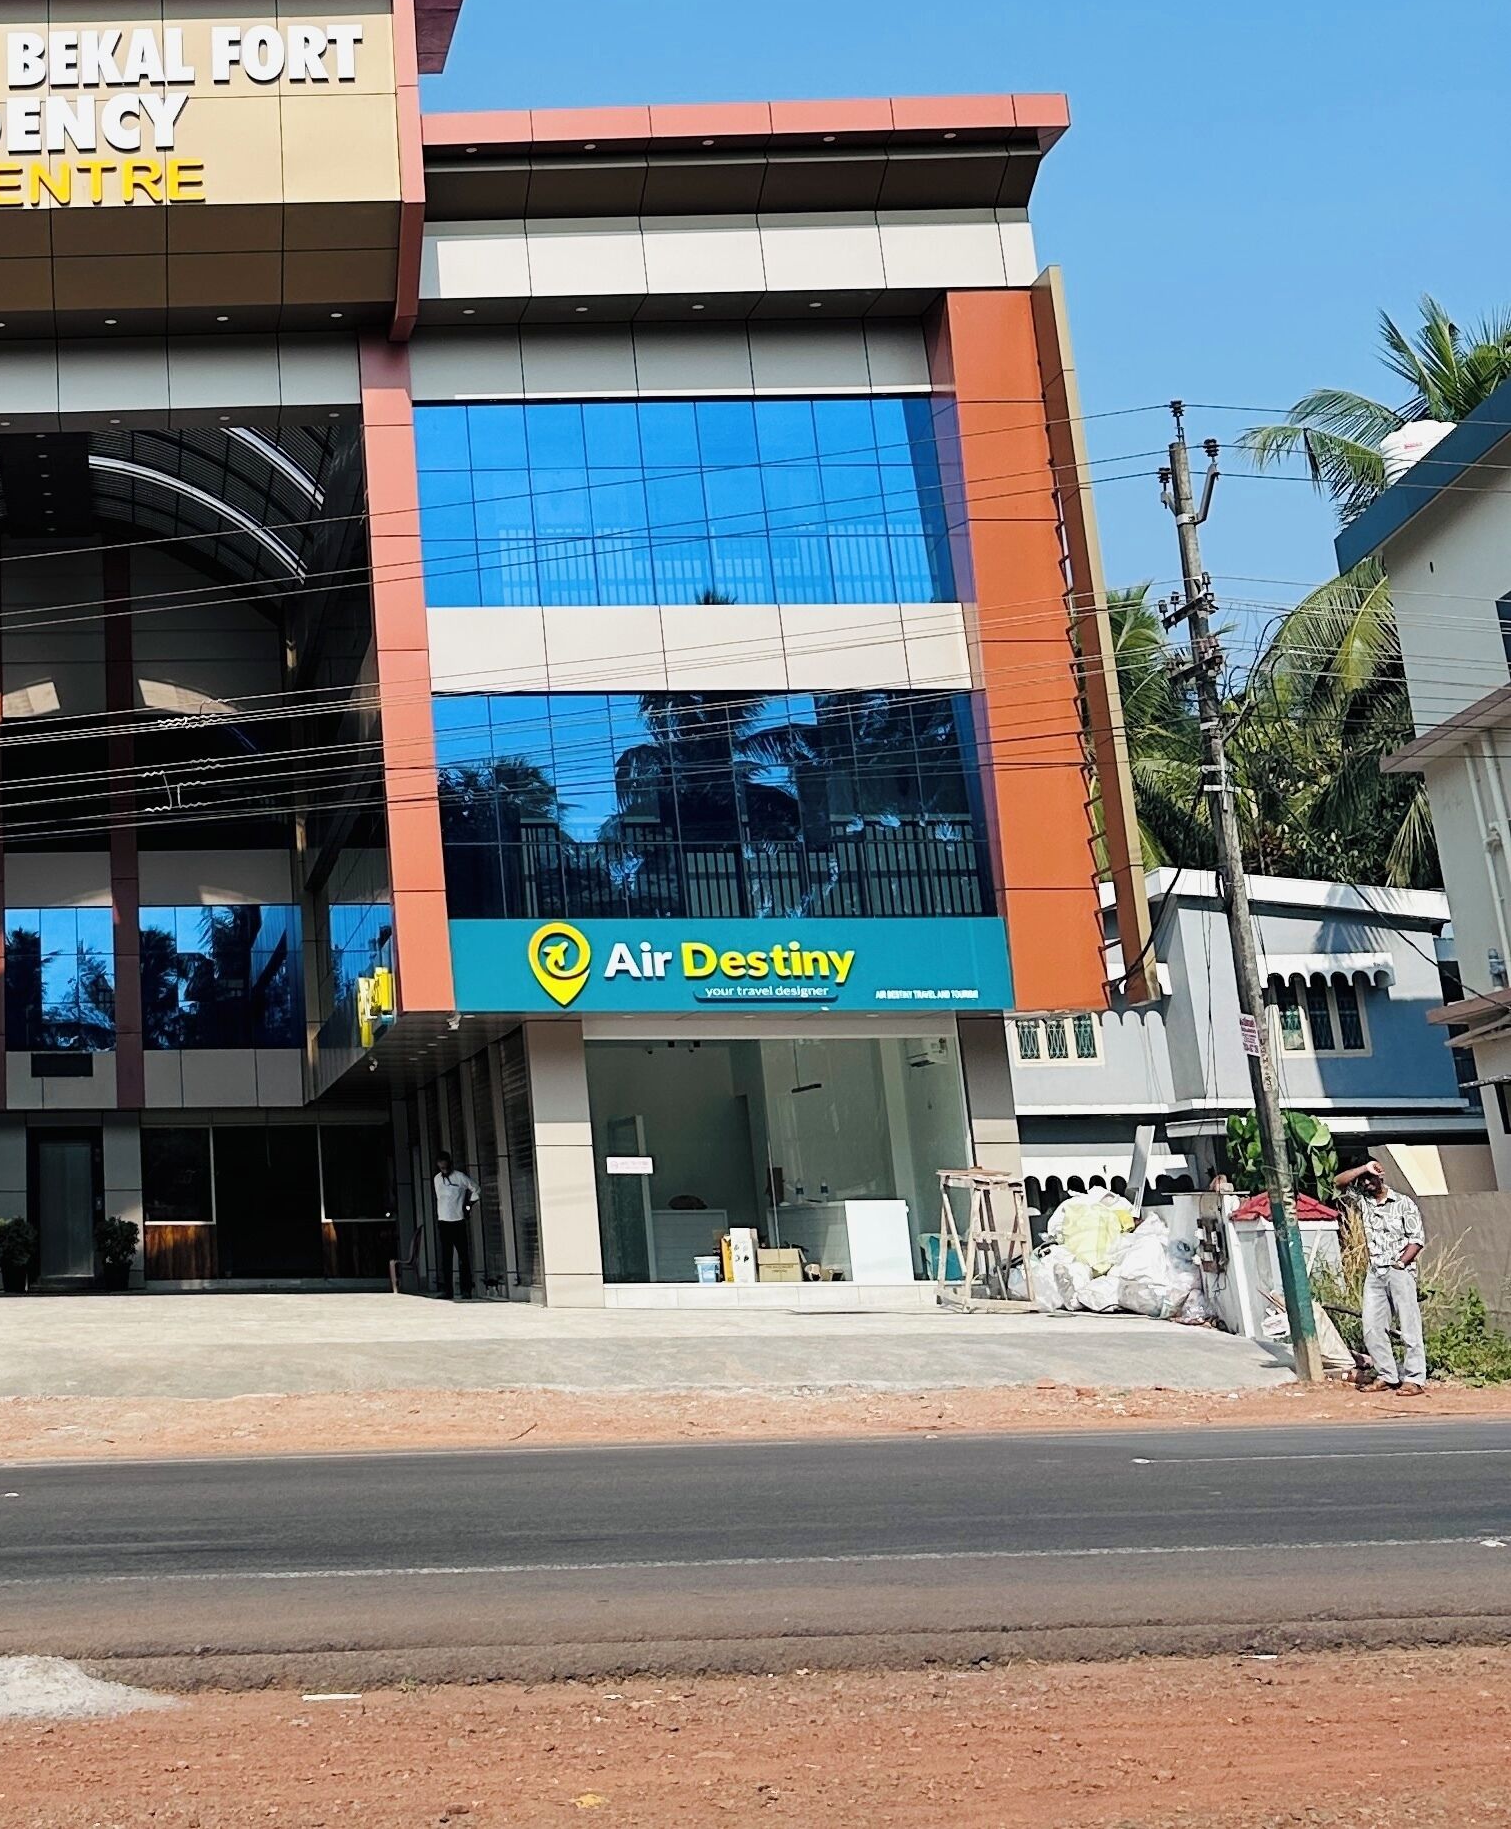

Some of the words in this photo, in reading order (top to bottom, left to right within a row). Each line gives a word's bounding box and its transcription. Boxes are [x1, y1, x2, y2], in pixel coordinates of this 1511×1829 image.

[7, 27, 195, 88] BEKAL
[212, 25, 362, 84] FORT
[604, 942, 672, 978] Air
[681, 942, 854, 984] Destiny
[704, 988, 734, 998] your
[736, 986, 773, 996] travel
[775, 985, 829, 998] designer
